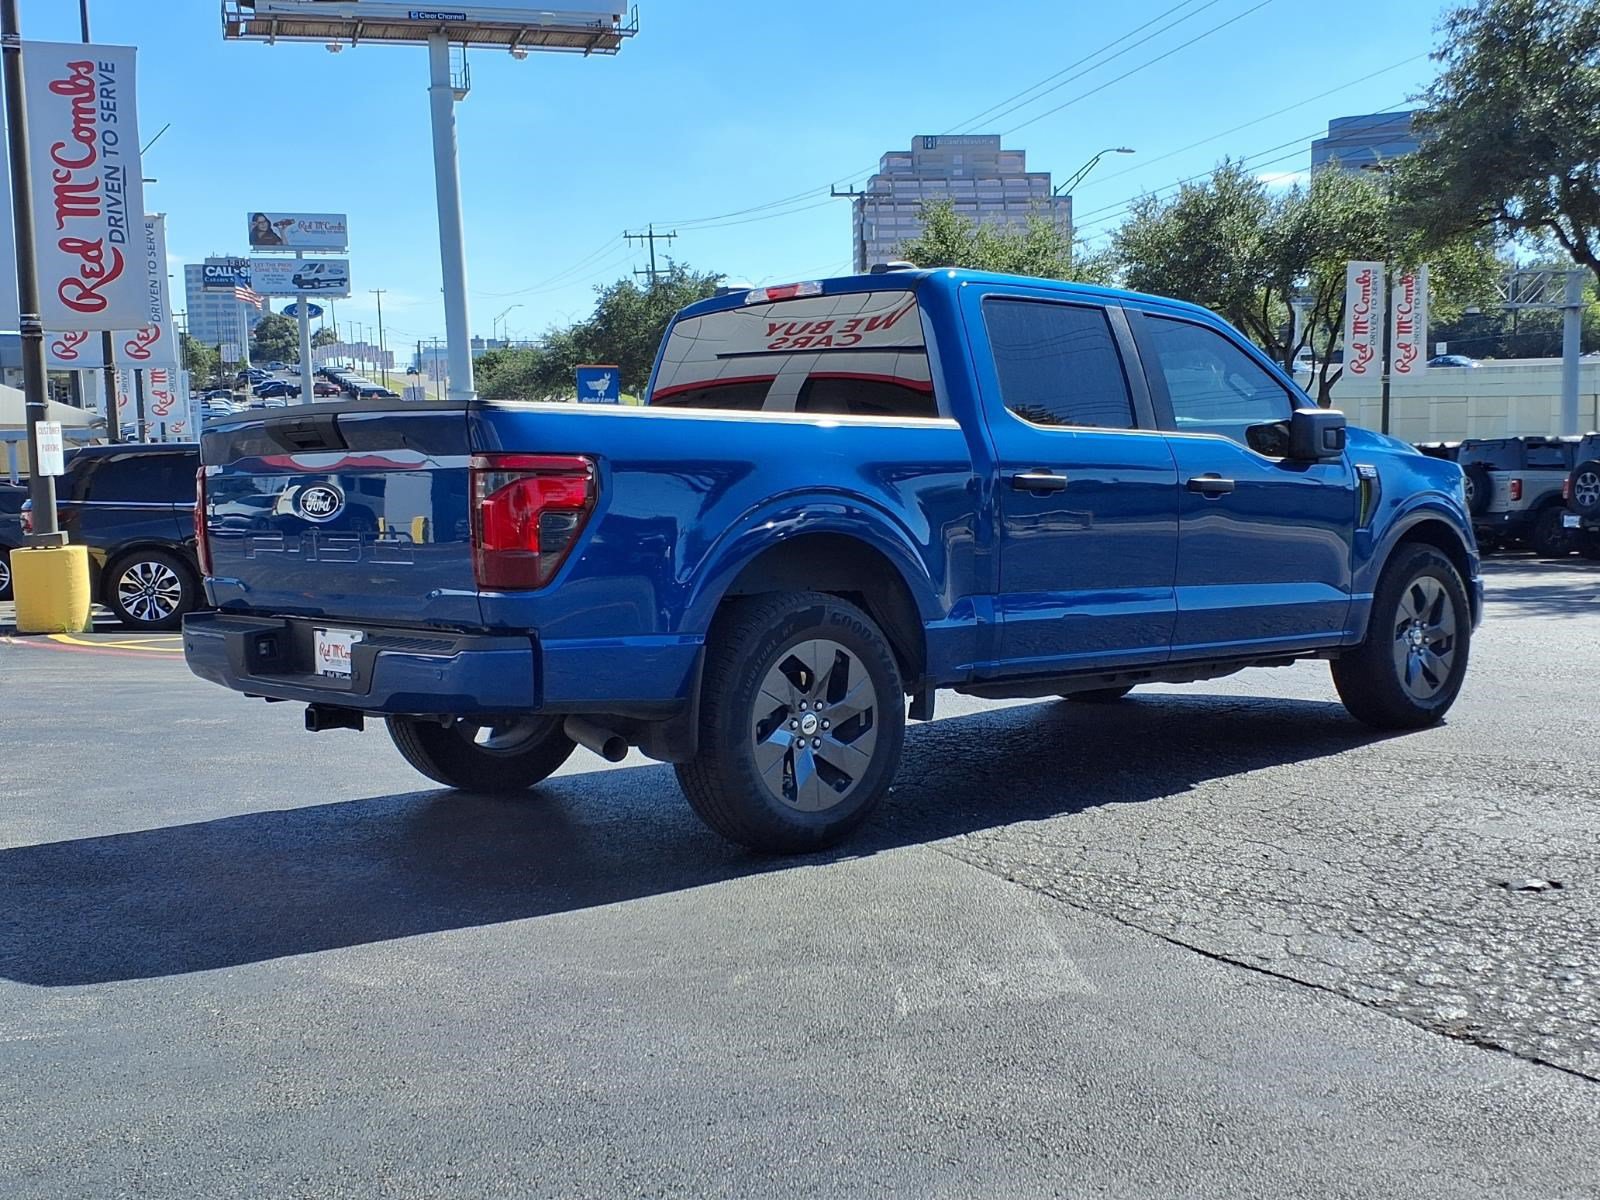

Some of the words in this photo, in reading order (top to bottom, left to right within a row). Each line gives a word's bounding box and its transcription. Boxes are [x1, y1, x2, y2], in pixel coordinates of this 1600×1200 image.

[98, 60, 117, 125] SERVE
[48, 60, 102, 231] McCombs
[102, 129, 120, 158] TO
[103, 165, 128, 245] DRIVEN
[144, 221, 156, 258] SERVE
[57, 236, 124, 314] Red
[148, 259, 158, 275] TO
[149, 280, 161, 323] DRIVEN
[1353, 268, 1371, 340] McCombs
[1371, 298, 1378, 310] TO
[1414, 298, 1421, 310] TO
[1369, 313, 1378, 346] DRIVEN
[1413, 312, 1421, 345] DRIVEN
[51, 331, 88, 360] Re
[1349, 343, 1374, 374] Red
[1394, 342, 1418, 374] Red
[151, 390, 175, 416] Red
[306, 491, 332, 512] Ford
